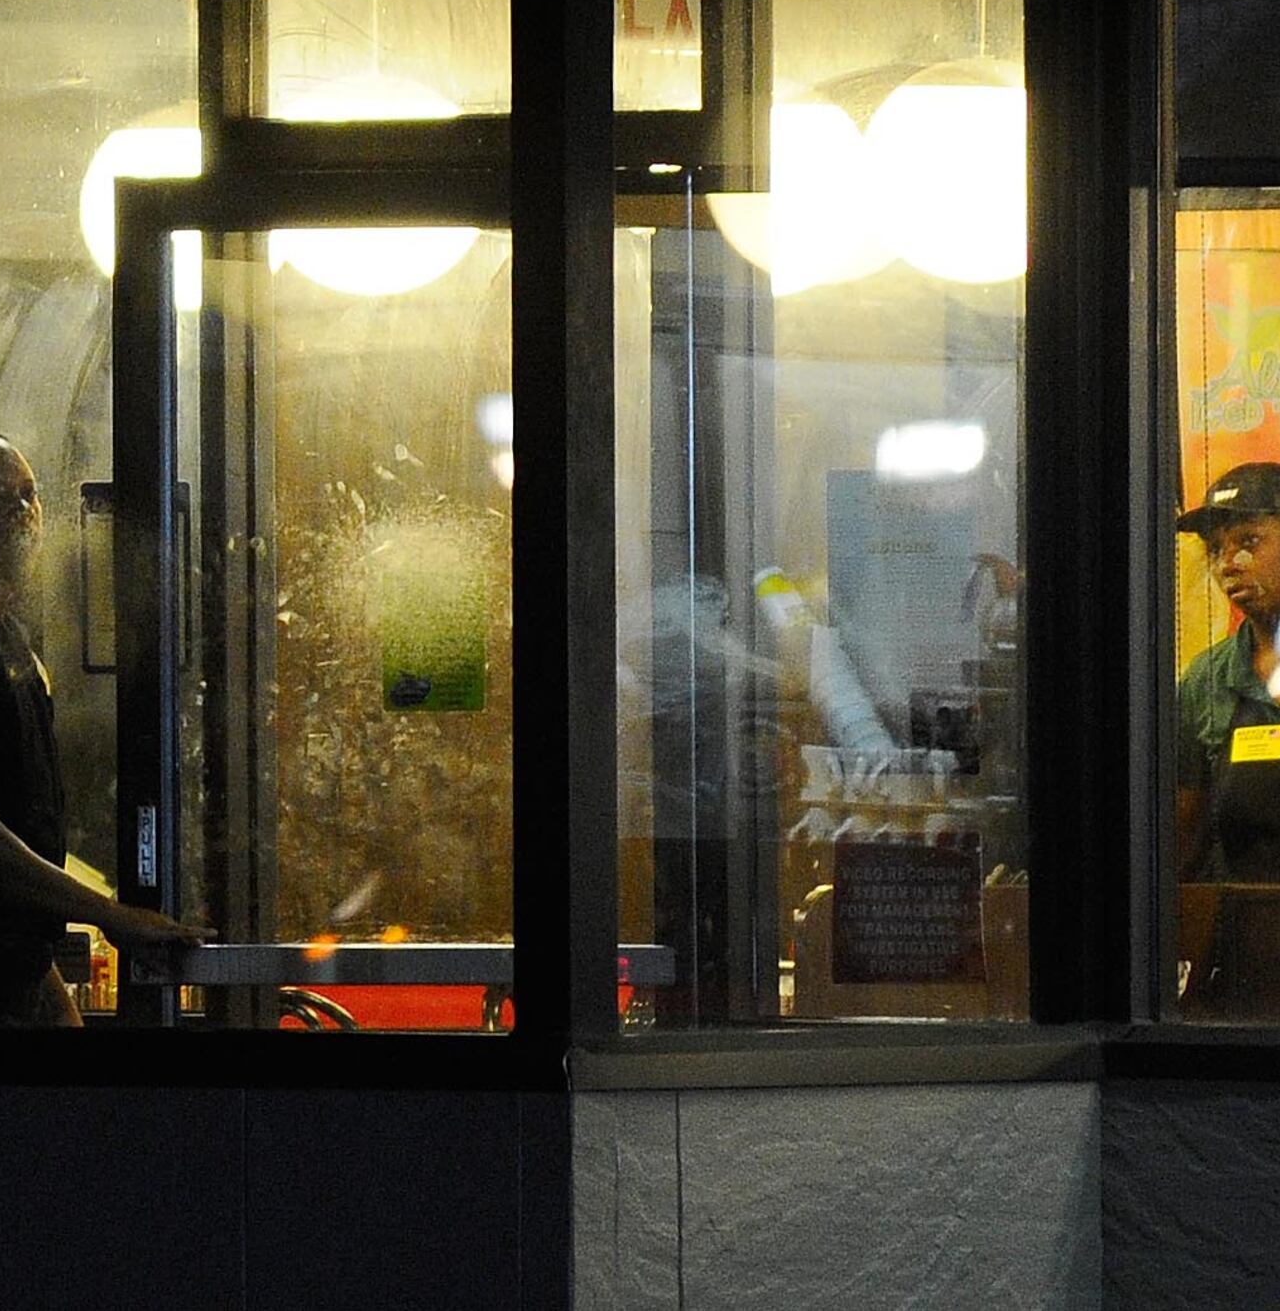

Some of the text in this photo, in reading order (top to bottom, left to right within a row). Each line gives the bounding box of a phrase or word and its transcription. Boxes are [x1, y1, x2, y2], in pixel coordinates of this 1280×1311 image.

[141, 816, 151, 876] PULL
[841, 866, 972, 881] VIDEO RECORDING
[852, 885, 908, 900] SYSTEM
[839, 903, 969, 918] FOR MANAGEMENT
[854, 940, 959, 955] INVESTIGATIVE
